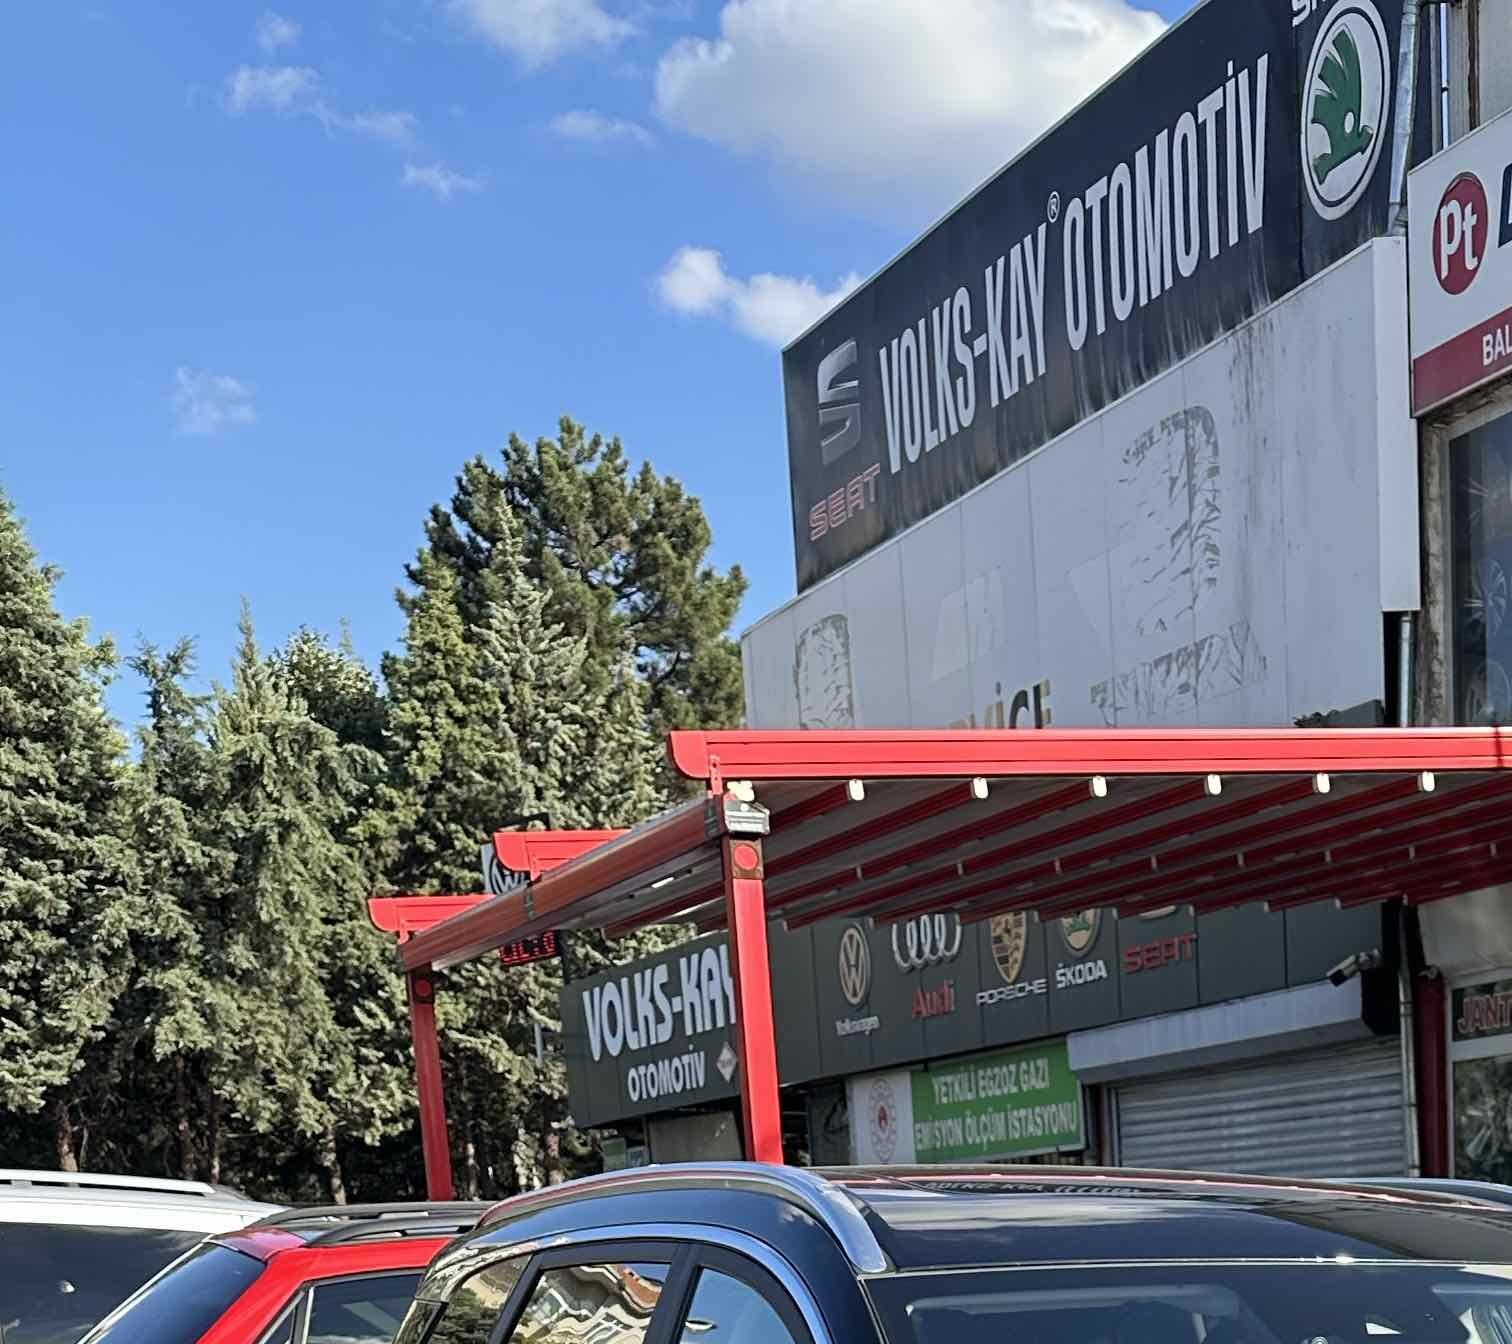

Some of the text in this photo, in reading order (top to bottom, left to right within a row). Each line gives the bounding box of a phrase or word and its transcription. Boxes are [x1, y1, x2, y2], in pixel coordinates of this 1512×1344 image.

[1063, 53, 1269, 351] OTOMOTİV
[809, 463, 881, 542] SEAT
[1122, 933, 1199, 973] SEAT
[582, 944, 737, 1062] VOLKS-KAY
[912, 979, 956, 1020] Audi
[975, 977, 1048, 1007] PORSCHE
[627, 1044, 705, 1103] OTOMOTİV
[978, 1063, 1019, 1099] EGZOZ
[1020, 1057, 1050, 1092] GAZI
